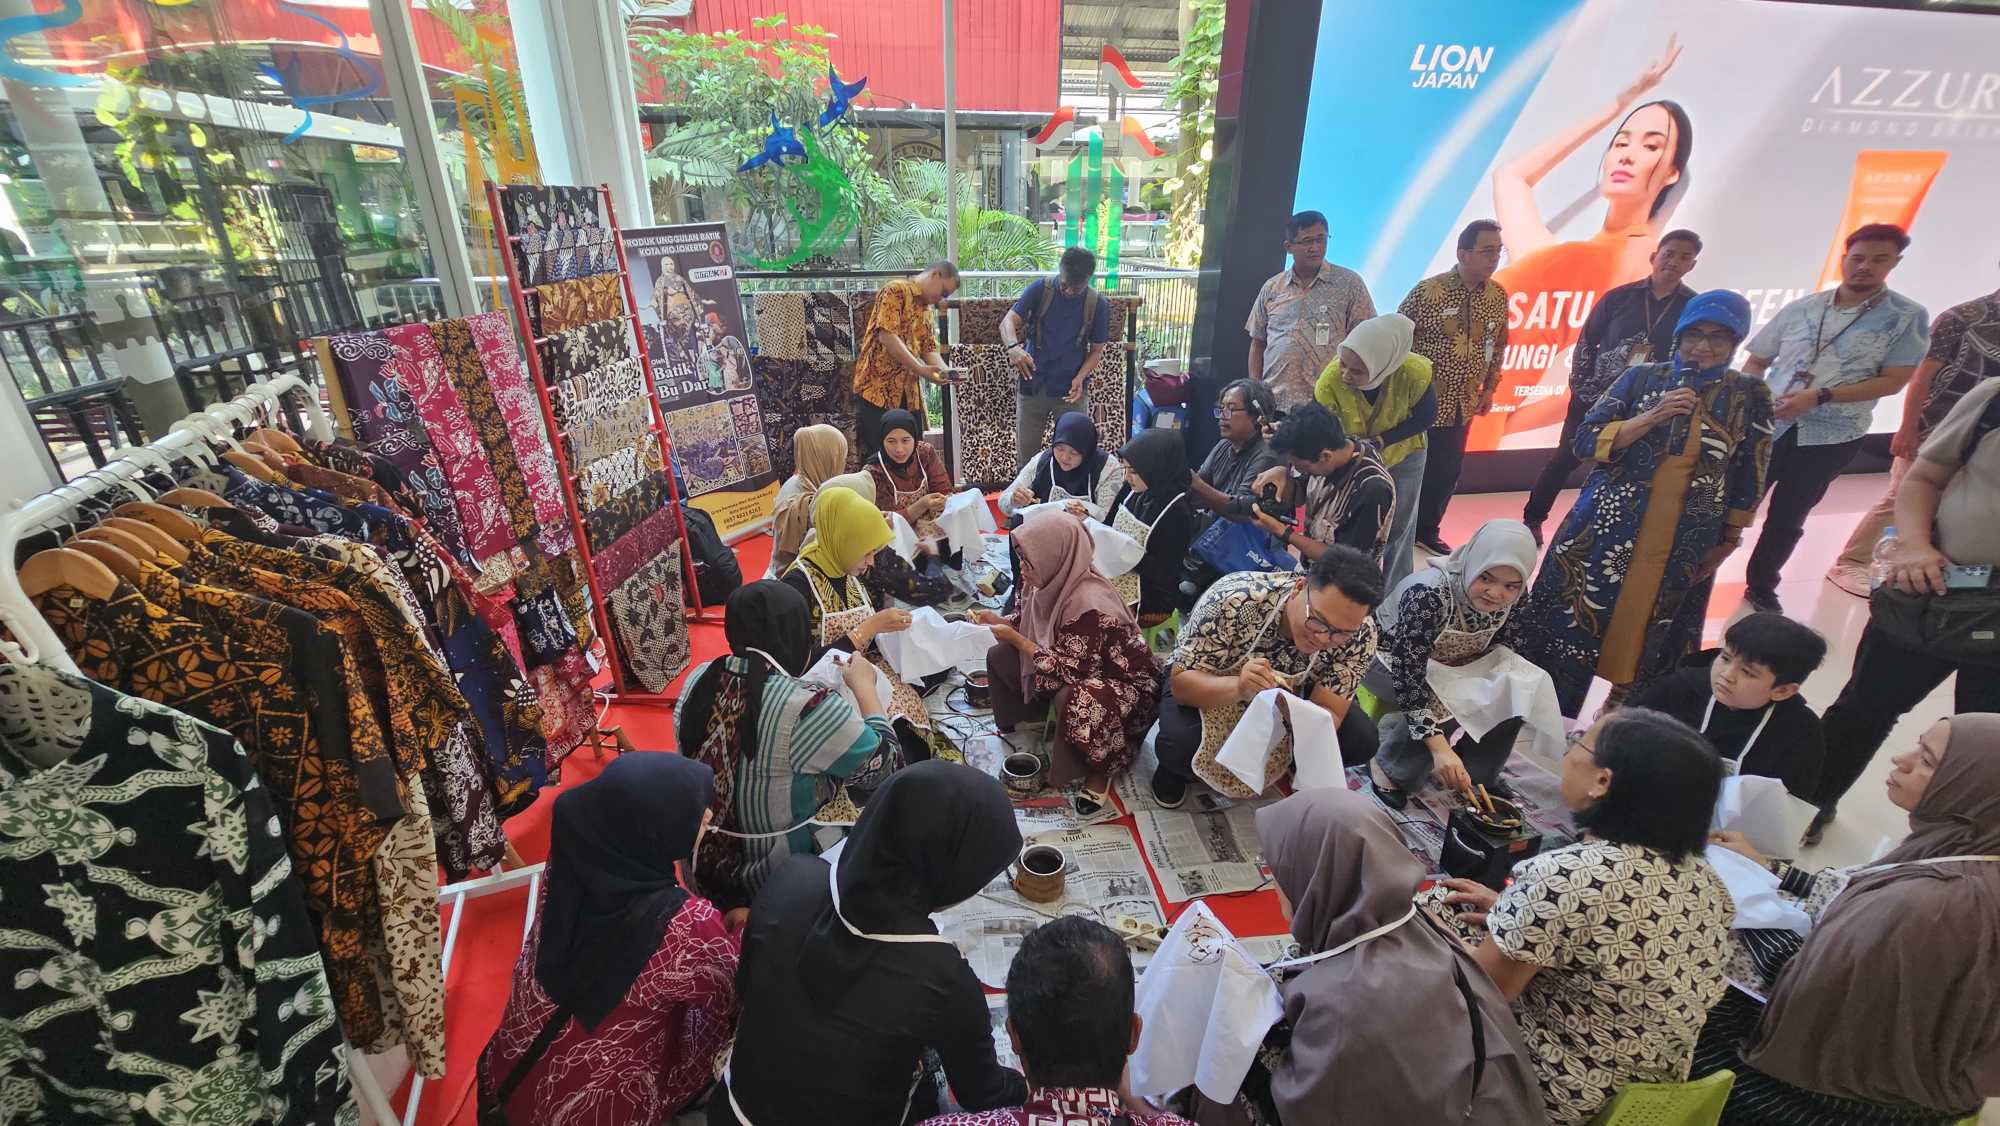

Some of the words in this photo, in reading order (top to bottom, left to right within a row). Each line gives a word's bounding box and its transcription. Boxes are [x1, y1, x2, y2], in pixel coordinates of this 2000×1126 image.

[1410, 44, 1495, 73] LION
[1412, 72, 1479, 89] JAPAN
[657, 233, 699, 245] UNGGULAN
[700, 231, 721, 241] BATIK
[640, 246, 661, 257] KOTA
[662, 242, 708, 255] MOJOKERTO
[1508, 291, 1595, 329] SATU
[1502, 343, 1558, 370] UNGI
[653, 362, 692, 381] Batik
[658, 384, 679, 399] Bu
[681, 380, 708, 394] Dar
